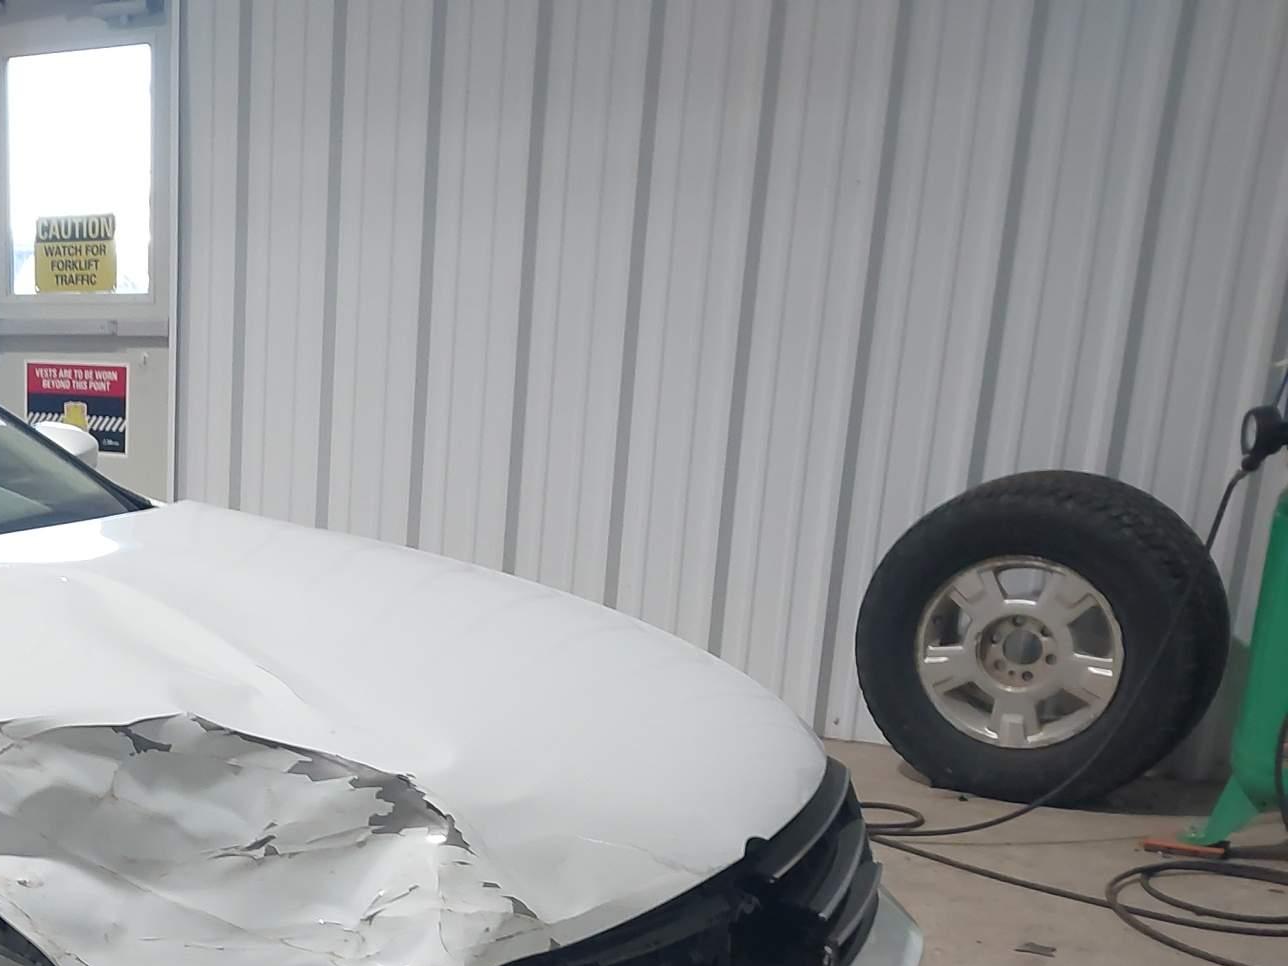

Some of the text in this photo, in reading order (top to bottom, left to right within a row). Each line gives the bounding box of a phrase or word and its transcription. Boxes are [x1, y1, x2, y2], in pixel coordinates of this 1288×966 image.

[38, 216, 113, 240] CAUTION
[44, 244, 107, 257] WATCH FOR
[51, 259, 99, 272] FORKLIFT
[55, 274, 97, 286] TRAFFIC
[35, 368, 118, 382] VESTS ARE TO BE WORN
[42, 379, 111, 392] BEYOND THIS POINT
